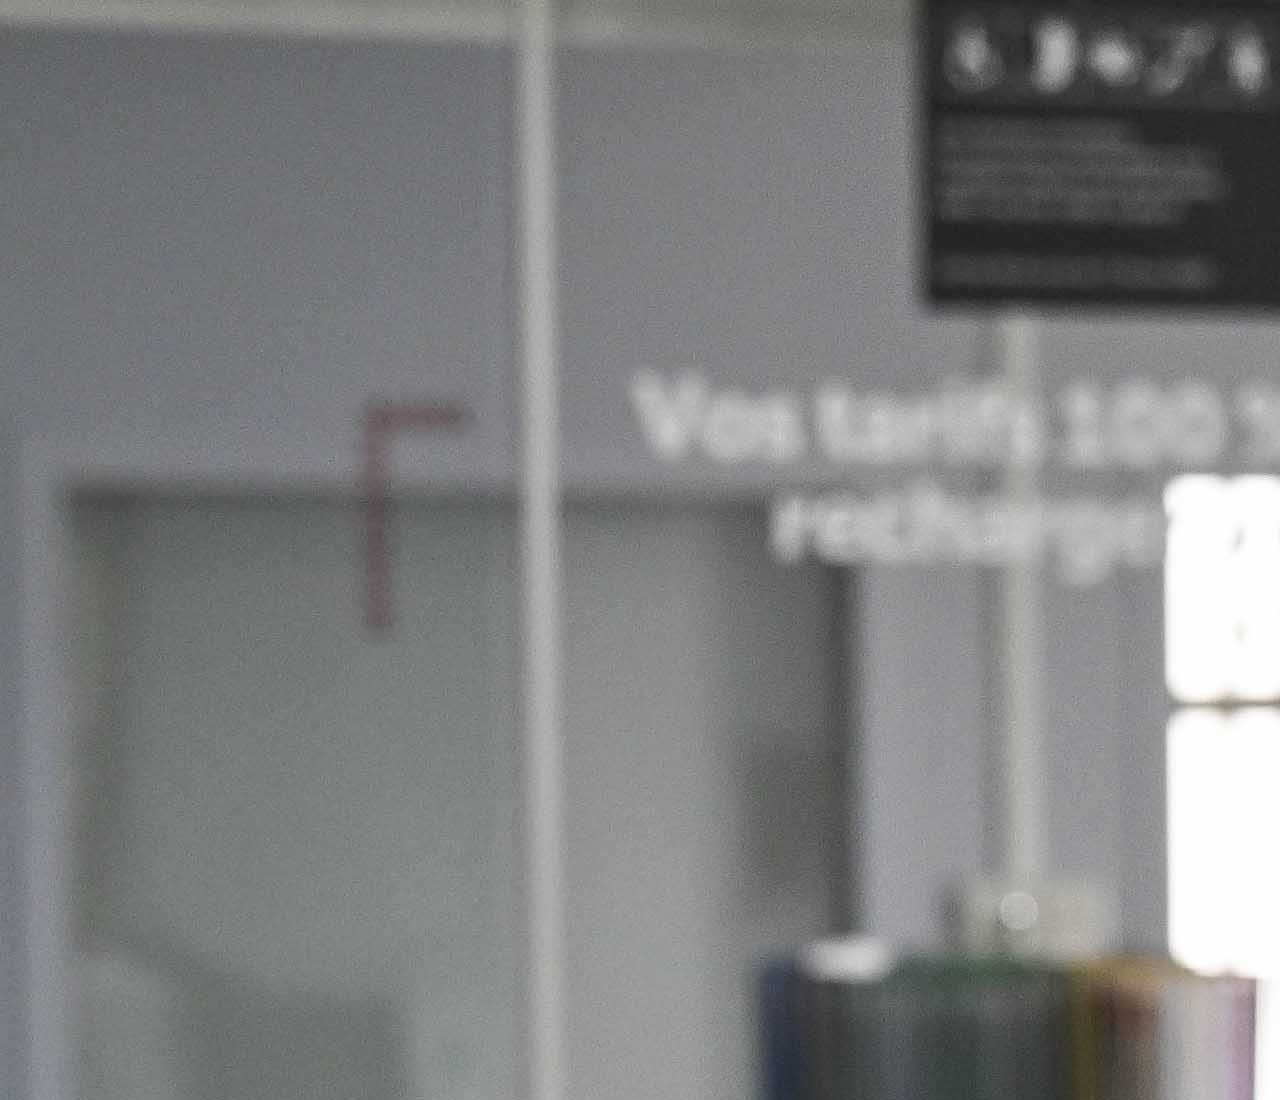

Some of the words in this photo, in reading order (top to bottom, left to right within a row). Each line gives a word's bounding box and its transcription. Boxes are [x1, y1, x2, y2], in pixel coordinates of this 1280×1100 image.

[632, 370, 800, 463] Vos
[1062, 380, 1226, 465] 100
[770, 488, 1212, 588] recharge
